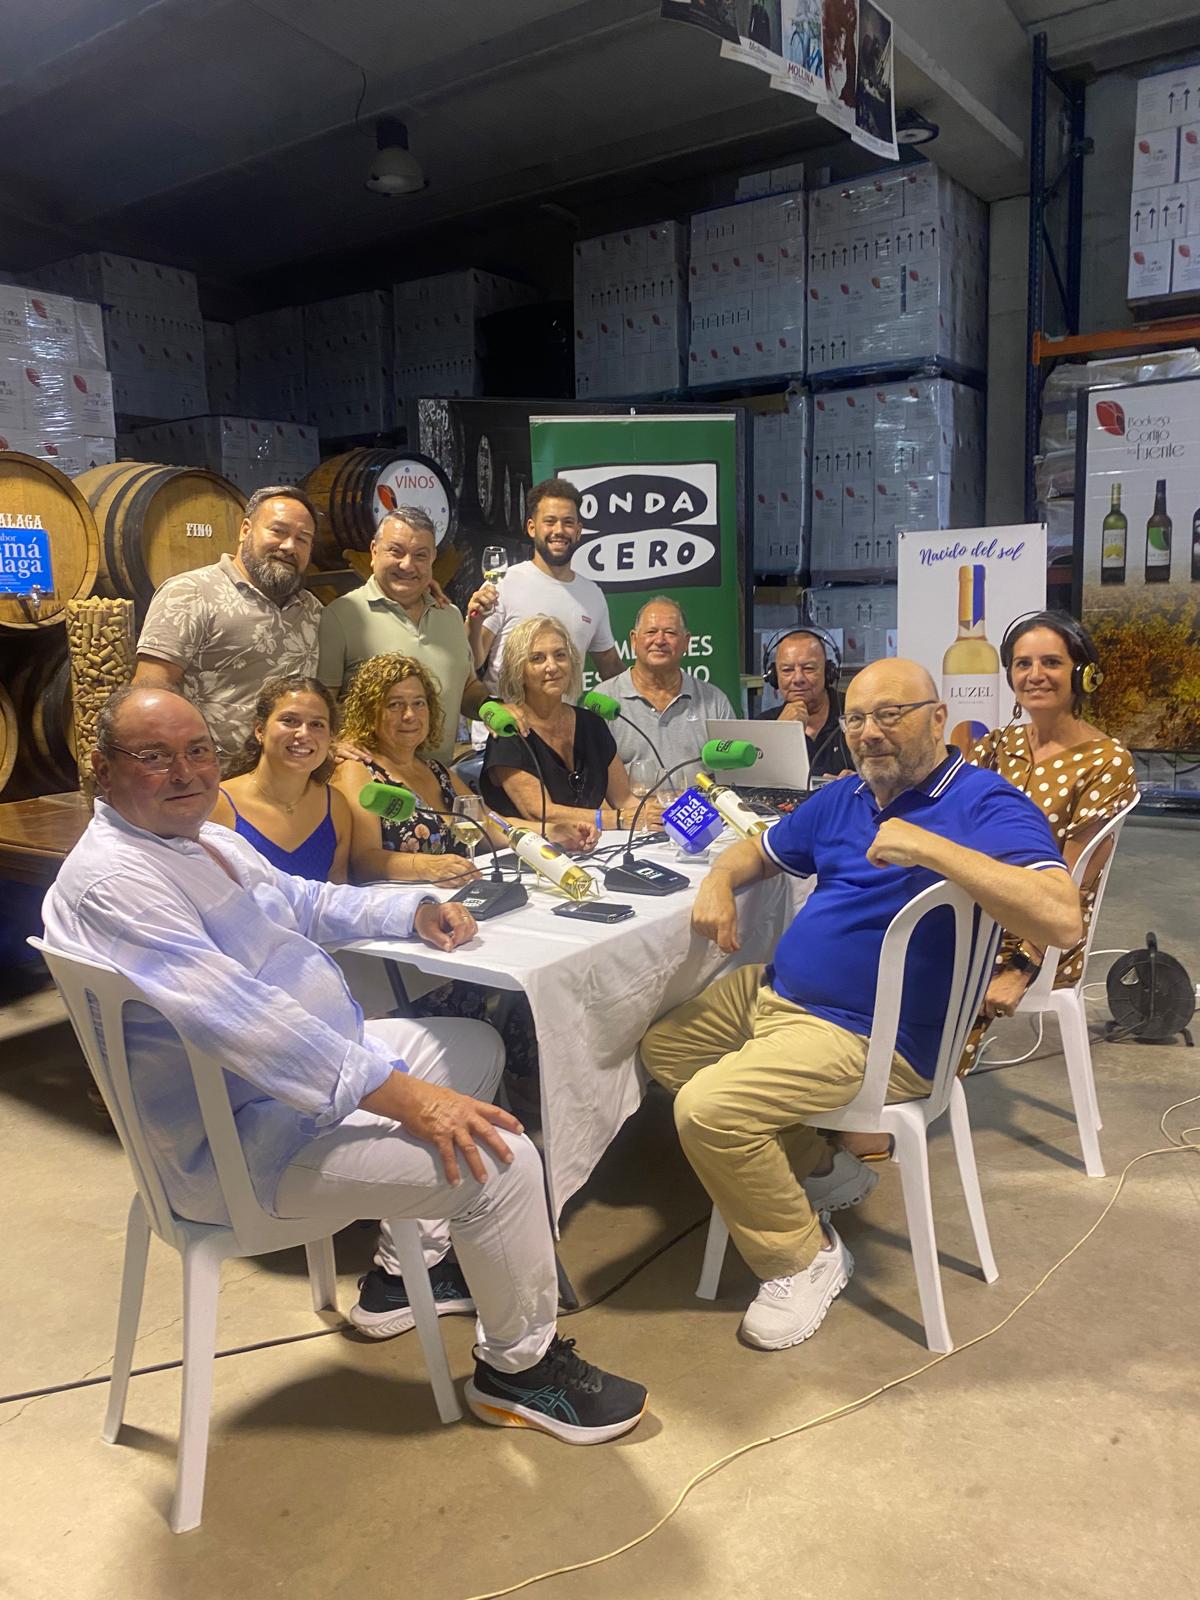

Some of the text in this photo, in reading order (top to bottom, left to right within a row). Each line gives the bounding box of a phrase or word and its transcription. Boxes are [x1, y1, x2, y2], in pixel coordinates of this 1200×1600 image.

[787, 62, 815, 86] MOLLINA
[395, 475, 435, 489] VINOS
[579, 491, 695, 519] ONDA
[0, 513, 44, 530] ALAGA
[185, 522, 213, 538] FINO
[587, 540, 696, 572] CERO
[920, 538, 1025, 566] Nacido del sol
[950, 685, 994, 698] LUZEL
[677, 805, 709, 831] laga
